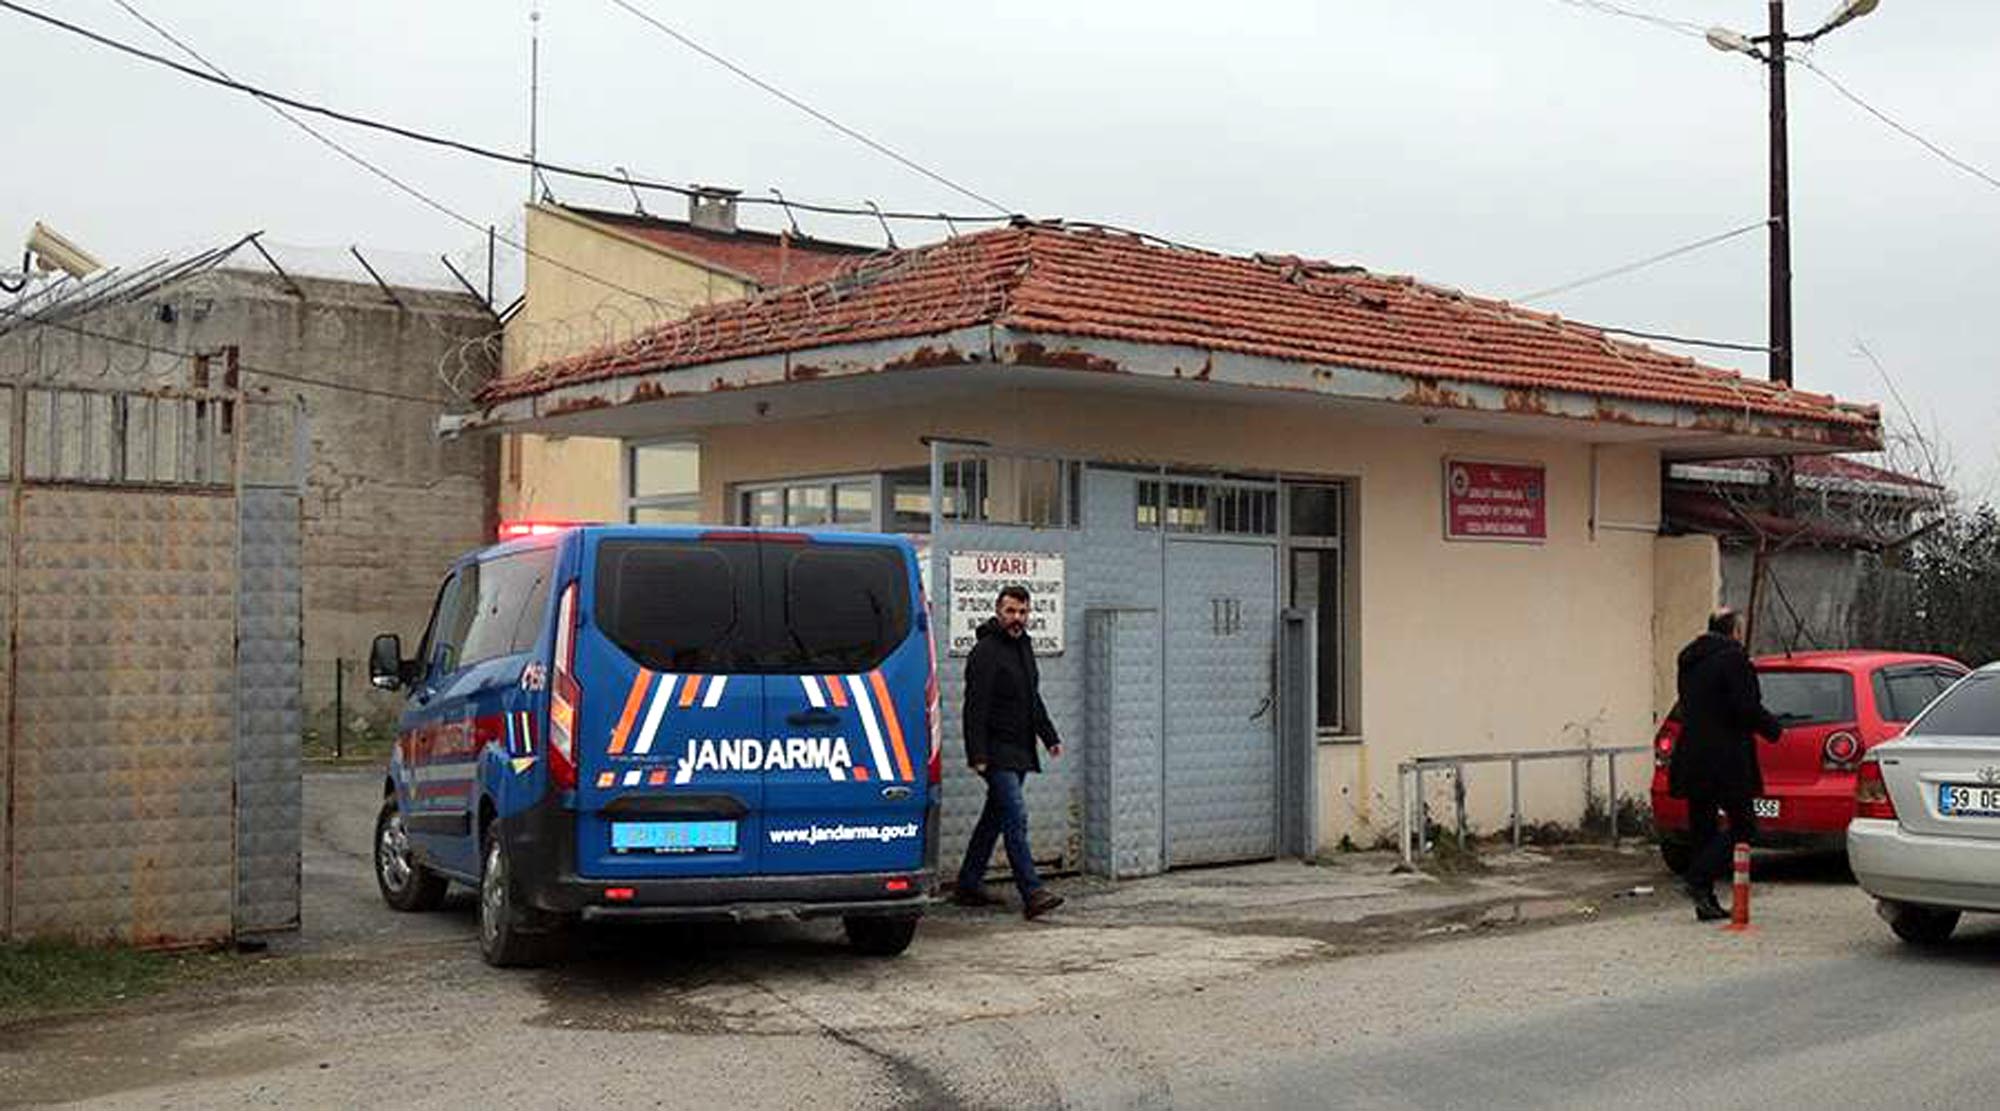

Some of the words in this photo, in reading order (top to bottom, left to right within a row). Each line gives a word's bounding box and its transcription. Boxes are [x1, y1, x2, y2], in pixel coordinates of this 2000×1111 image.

[976, 555, 1028, 575] UYARI
[678, 738, 852, 770] JANDARMA
[1951, 788, 1970, 807] 59
